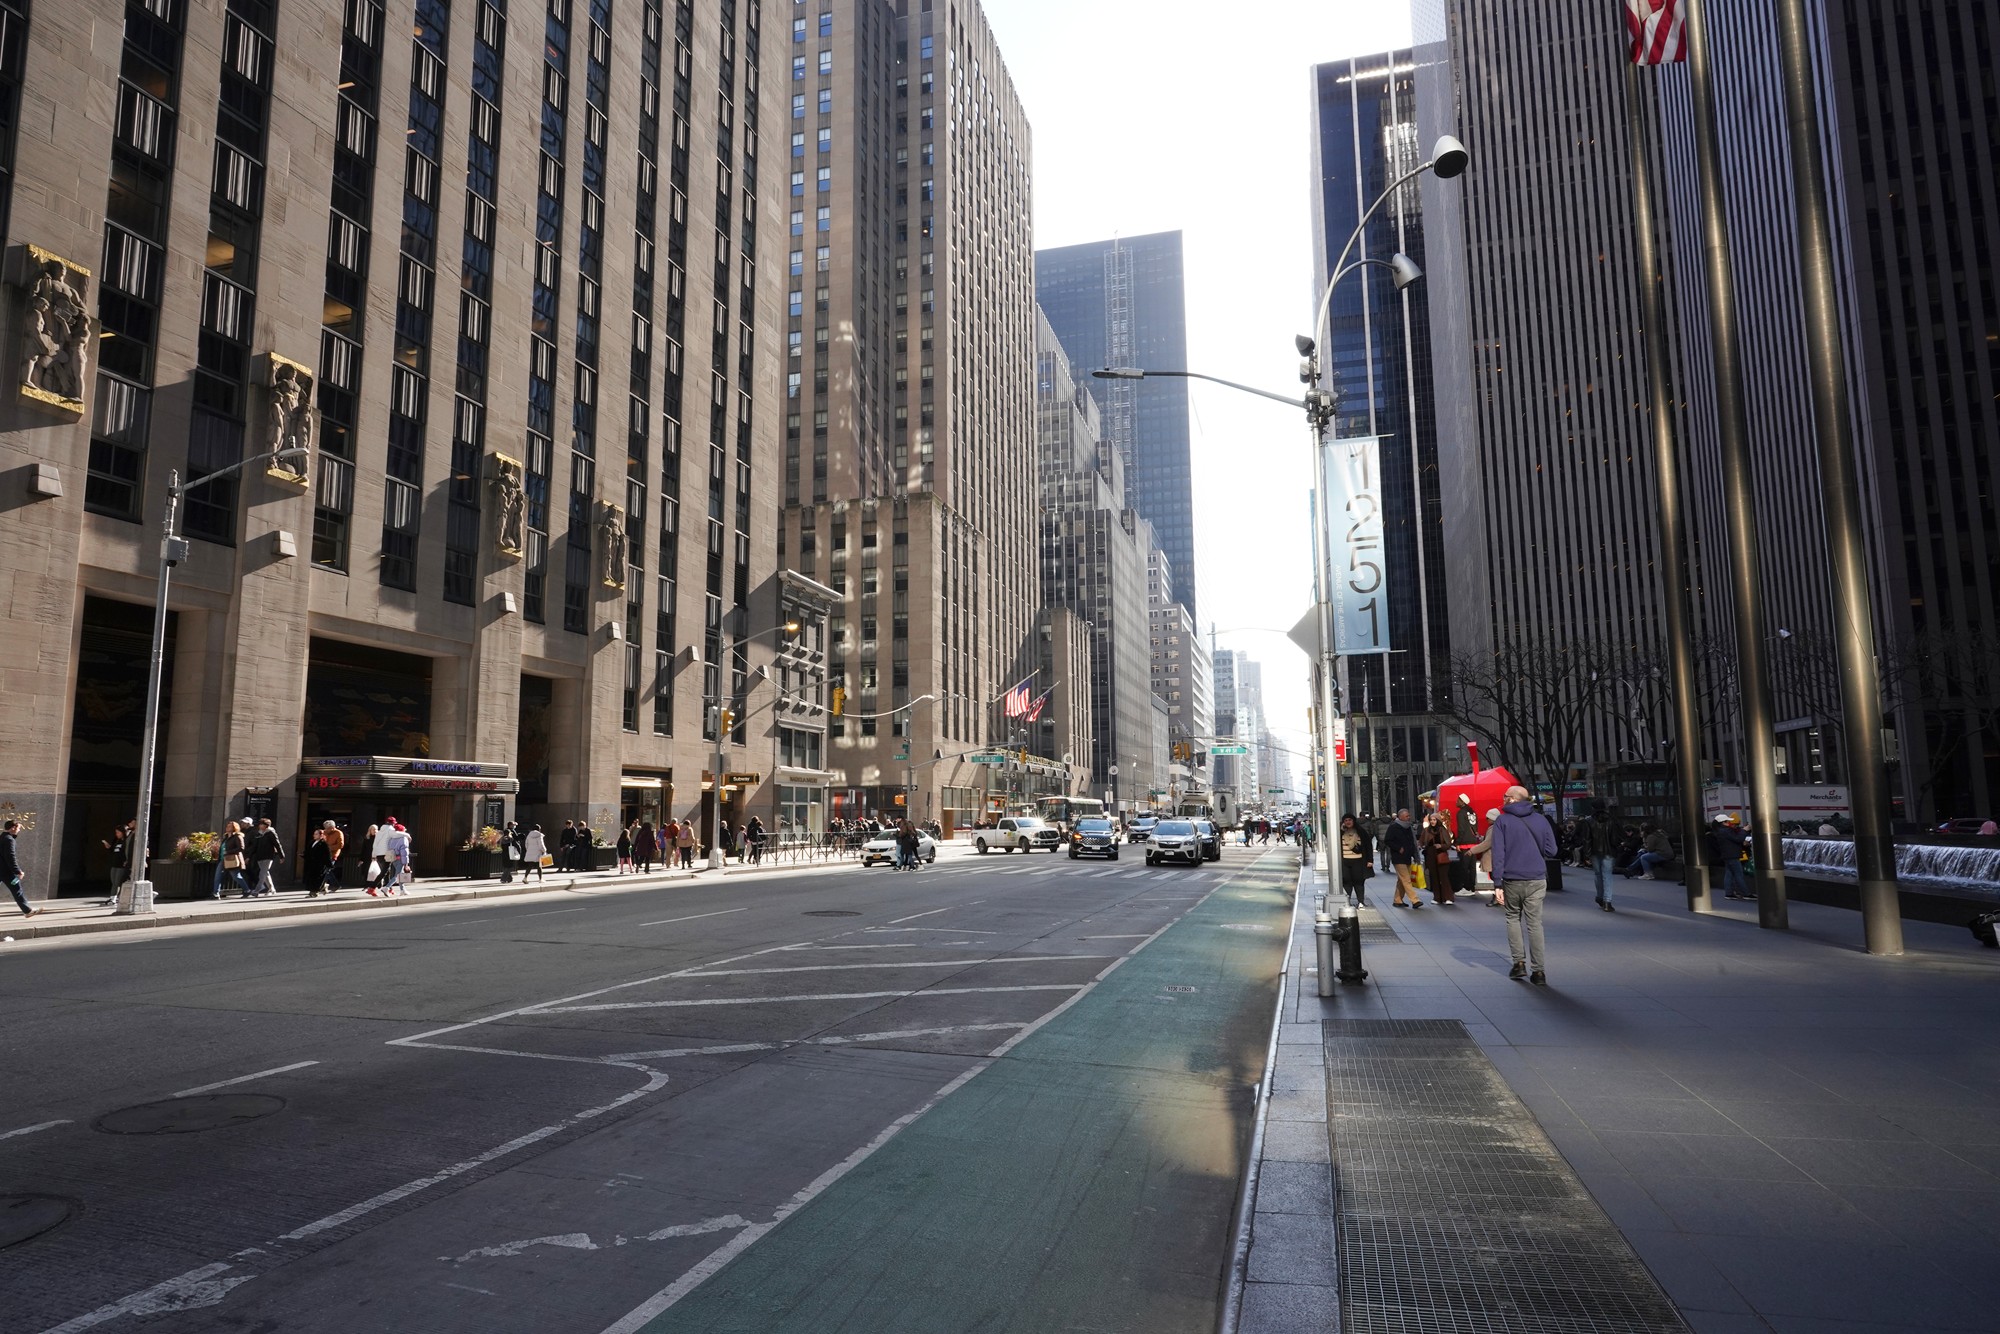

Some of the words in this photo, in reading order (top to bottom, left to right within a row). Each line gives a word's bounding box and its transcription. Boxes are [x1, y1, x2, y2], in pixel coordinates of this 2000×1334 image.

[1346, 444, 1382, 646] 1251
[1335, 564, 1343, 590] AVENUE
[1337, 602, 1345, 614] THE
[1338, 615, 1346, 649] AMERICAS
[427, 762, 459, 772] TONIGHT
[309, 776, 340, 788] NBC
